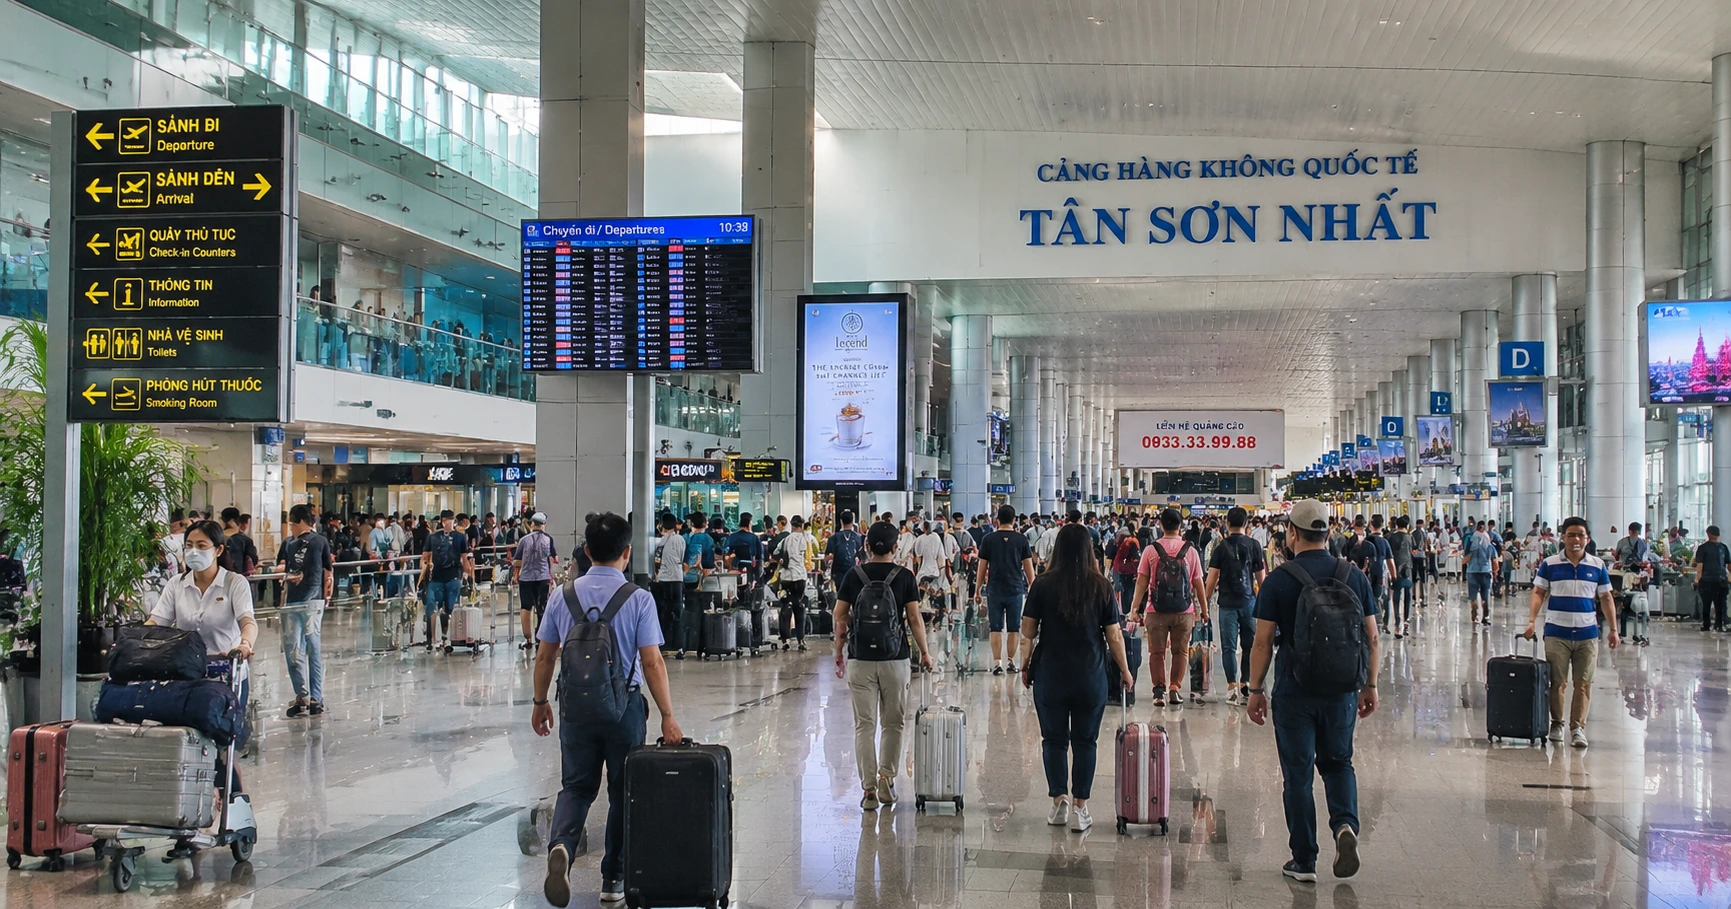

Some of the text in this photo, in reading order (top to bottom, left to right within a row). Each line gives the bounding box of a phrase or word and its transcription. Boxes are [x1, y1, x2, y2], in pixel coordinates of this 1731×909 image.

[157, 139, 215, 153] Departure
[1036, 148, 1419, 182] CẢNG HÀNG KHÔNG QUỐC TẾ
[155, 193, 195, 206] Arrival
[1019, 186, 1438, 247] TÂN SƠN NHẤT
[149, 246, 237, 258] Check-in Counters
[193, 279, 213, 291] TIN
[148, 297, 200, 307] Information
[195, 329, 224, 342] SINH
[147, 346, 177, 358] Toilets
[1511, 347, 1531, 370] D
[145, 397, 217, 410] Smoking Room
